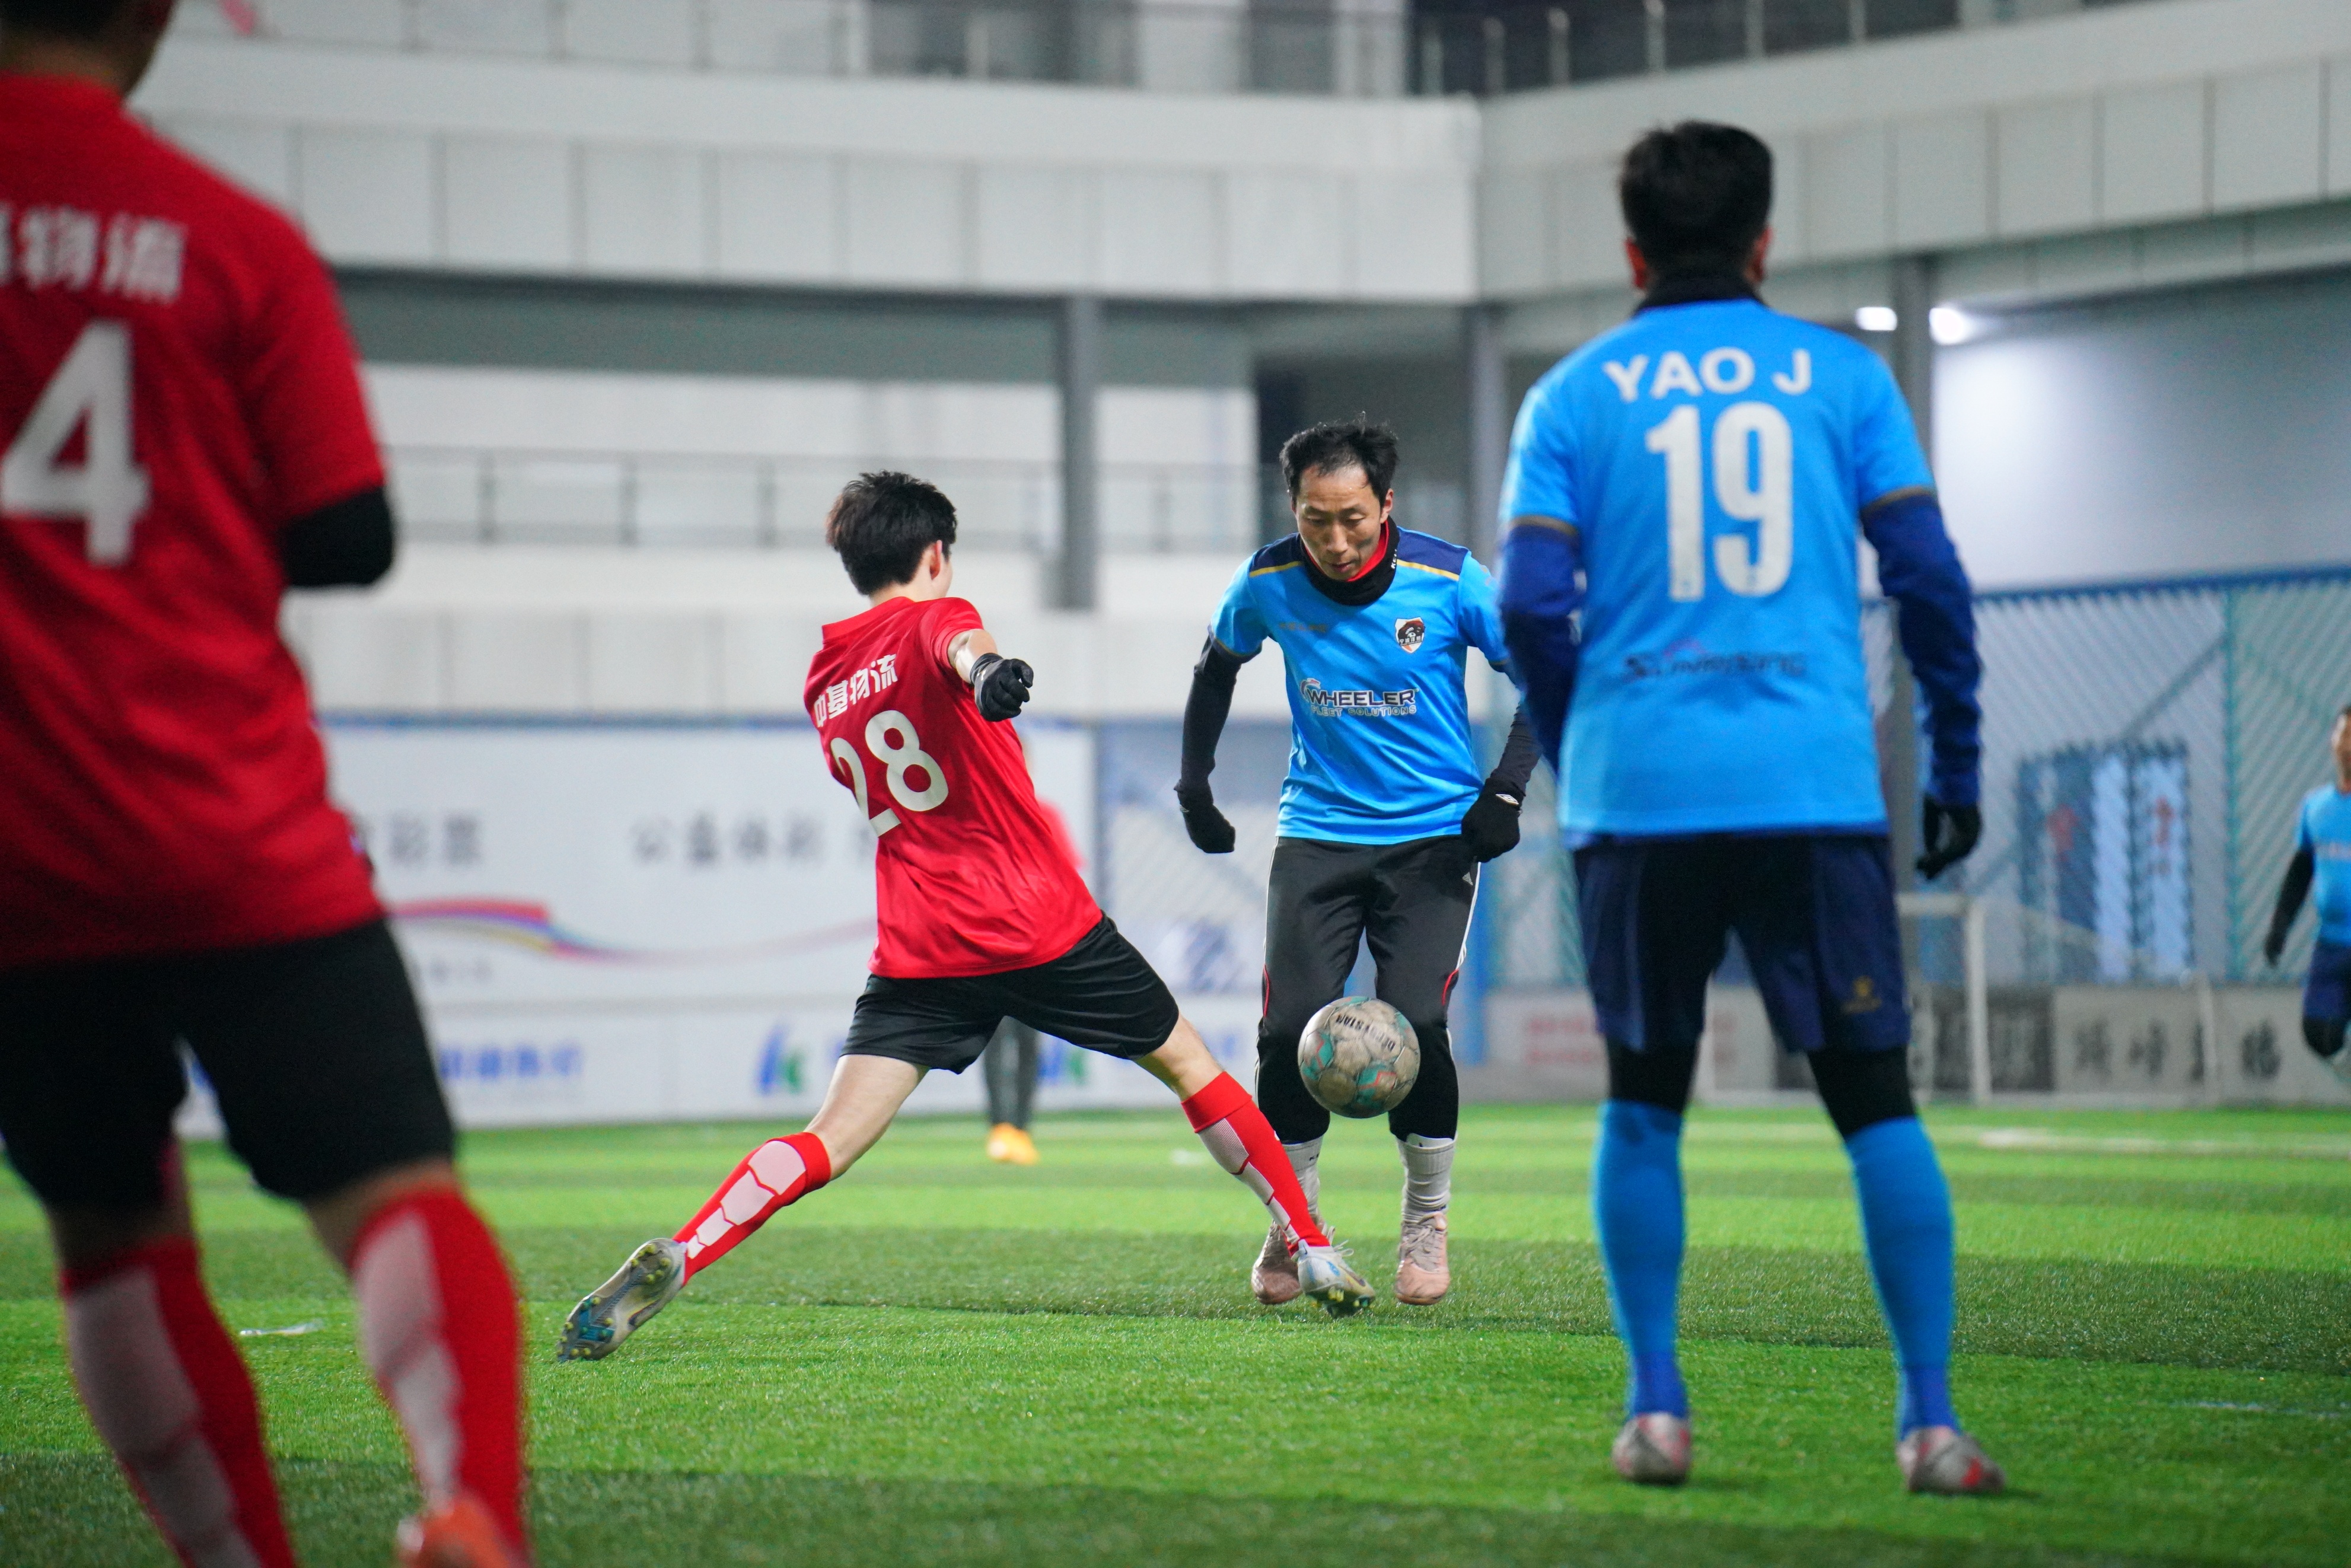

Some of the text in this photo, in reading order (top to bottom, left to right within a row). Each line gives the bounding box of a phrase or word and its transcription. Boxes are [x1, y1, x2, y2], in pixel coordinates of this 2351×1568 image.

[1603, 347, 1812, 402] YAO J
[0, 319, 150, 569] 4
[1645, 401, 1793, 601] 19
[814, 654, 898, 727] 中基物流
[1306, 688, 1415, 707] WHEELER
[1310, 705, 1417, 717] FLEET SOLUTIONS
[829, 709, 949, 837] 28
